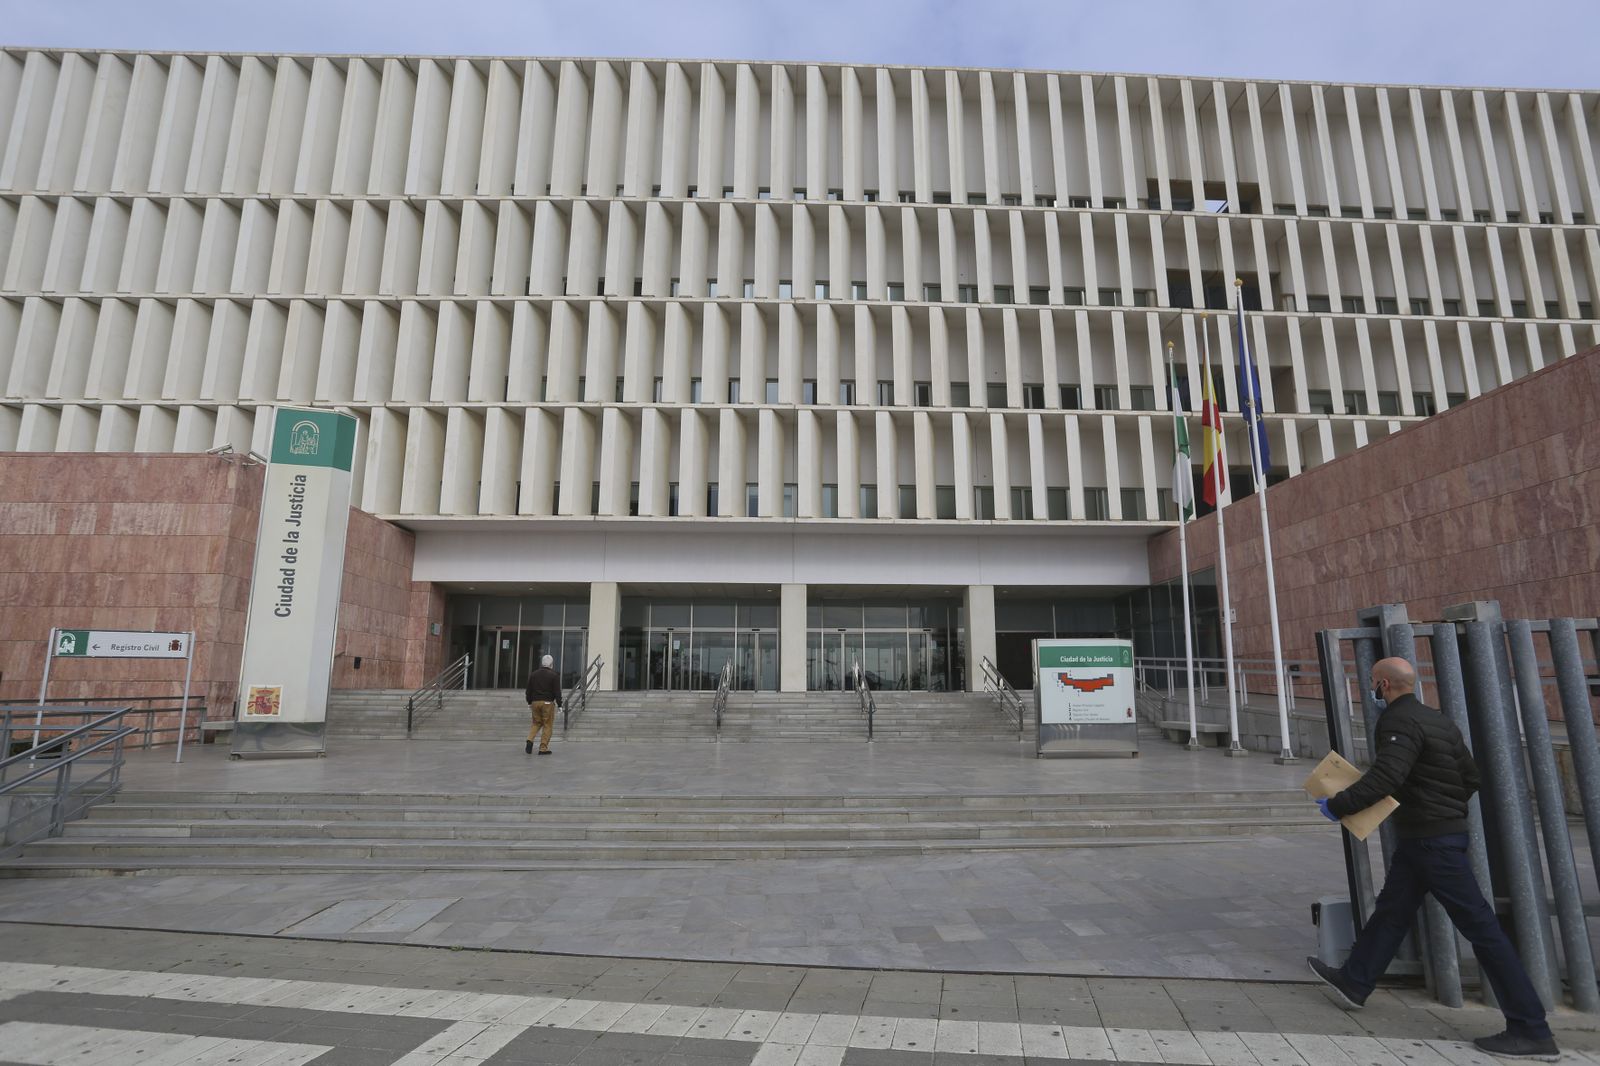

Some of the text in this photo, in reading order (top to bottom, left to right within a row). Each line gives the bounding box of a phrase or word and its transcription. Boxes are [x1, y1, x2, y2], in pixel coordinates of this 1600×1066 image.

[274, 474, 307, 618] Ciudad de la Justicia
[110, 644, 160, 652] Registro Civil
[1060, 655, 1113, 663] Ciudad de la Justicia
